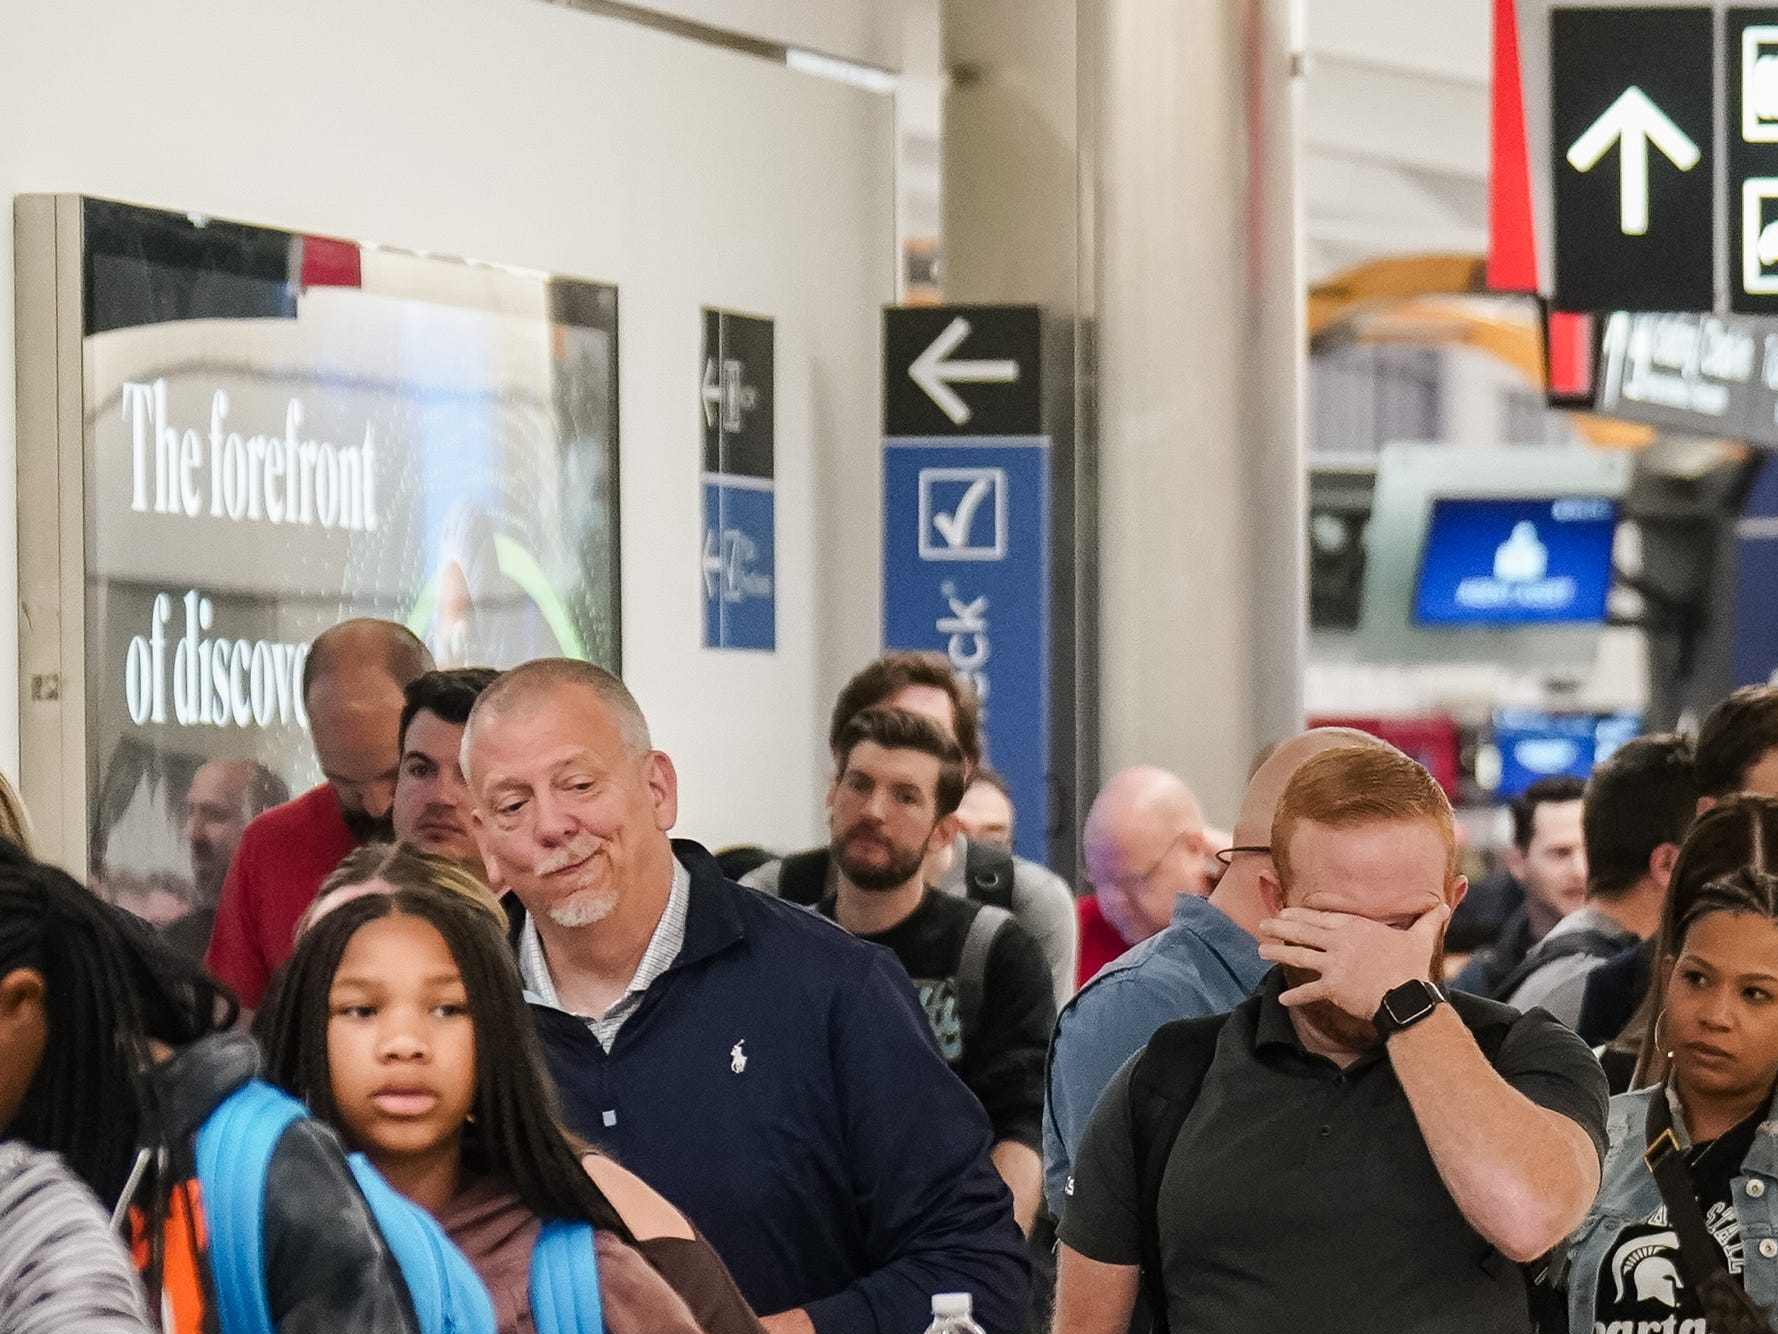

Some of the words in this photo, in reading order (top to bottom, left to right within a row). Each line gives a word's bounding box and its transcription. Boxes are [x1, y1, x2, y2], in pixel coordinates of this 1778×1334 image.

[123, 379, 202, 515] The
[210, 388, 378, 534] forefront
[126, 593, 172, 727] of
